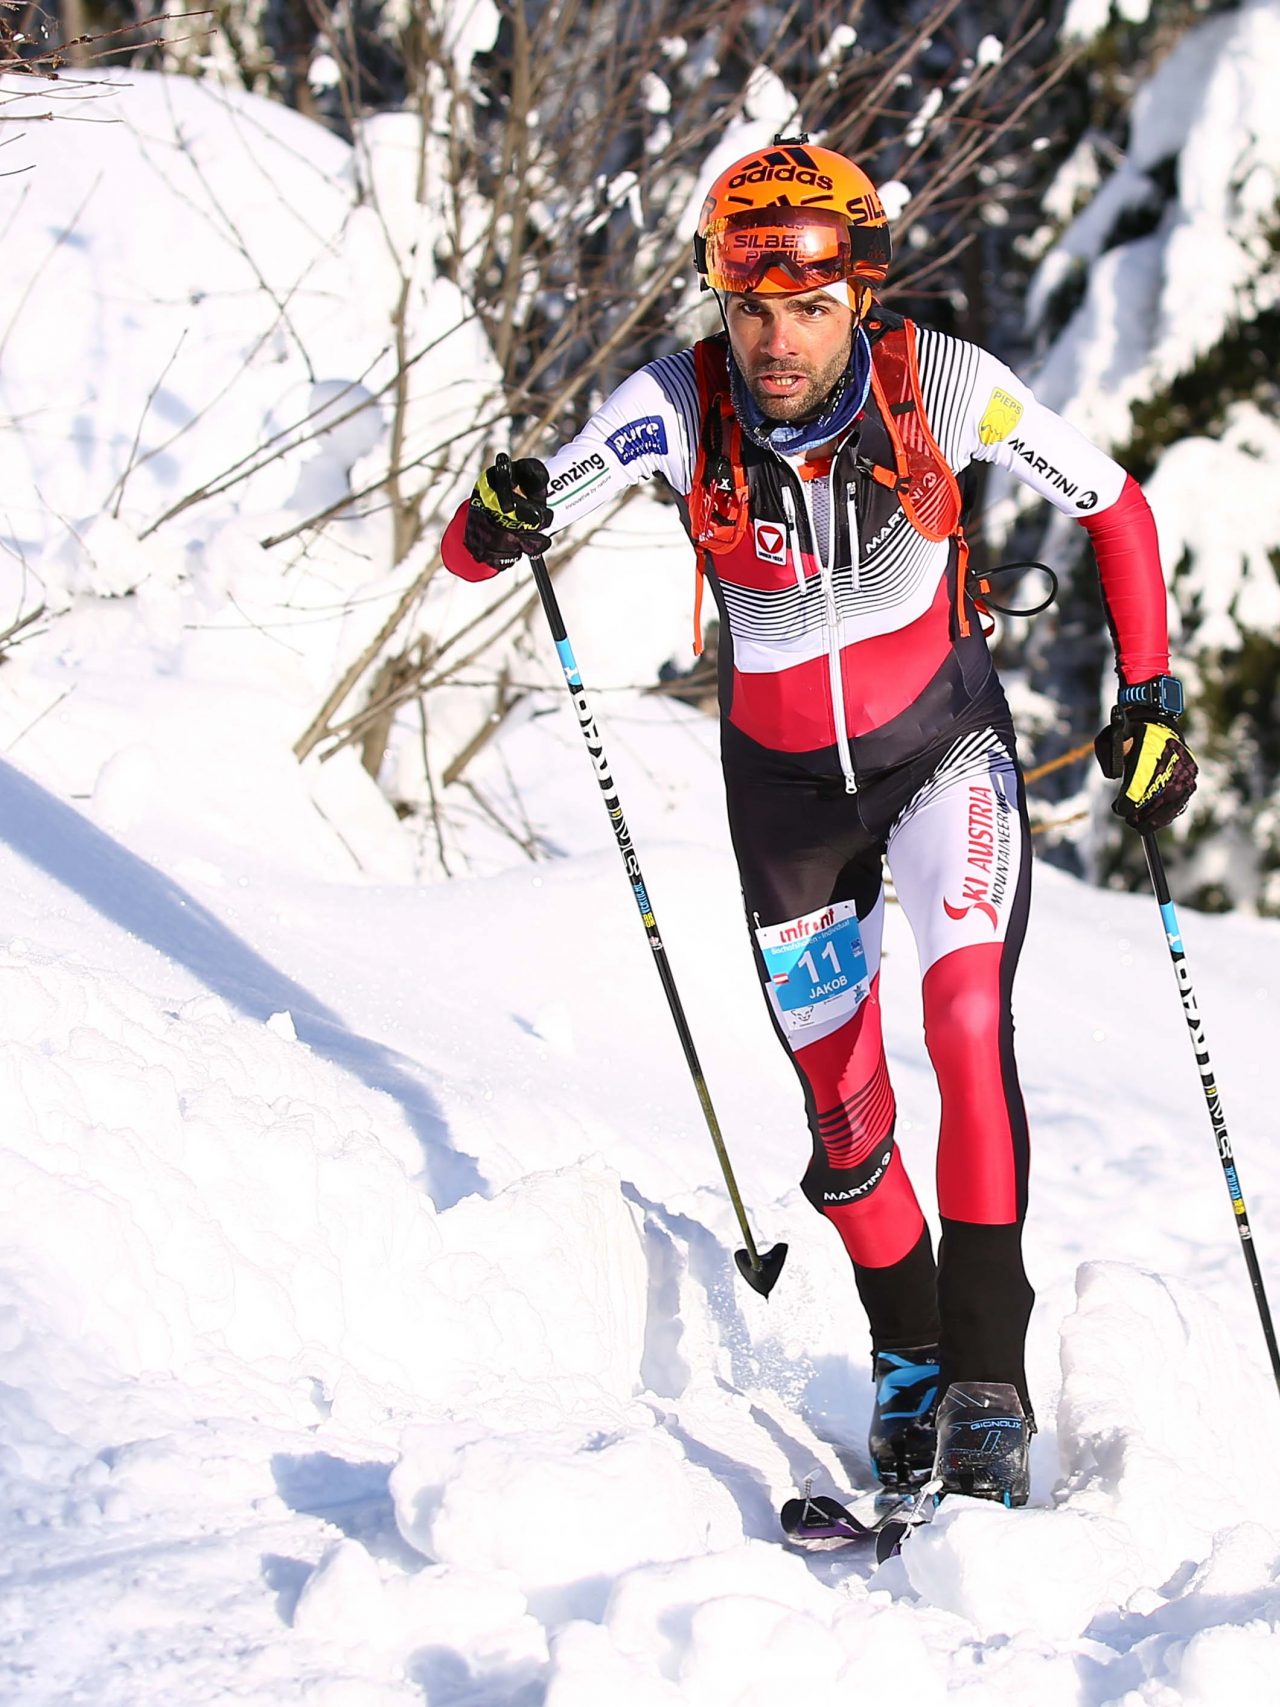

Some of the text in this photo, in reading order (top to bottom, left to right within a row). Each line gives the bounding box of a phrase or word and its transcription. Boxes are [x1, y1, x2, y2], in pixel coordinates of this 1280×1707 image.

[728, 165, 833, 191] adidas
[993, 391, 1022, 415] PIEPS
[613, 422, 659, 455] pure
[1008, 438, 1078, 498] MARTINI
[866, 487, 924, 554] MARNI
[967, 786, 994, 874] AUSTRIA
[991, 789, 1011, 909] MOUNTAINEERING
[779, 907, 835, 944] infront
[798, 940, 842, 984] 11
[809, 975, 848, 999] JAKOB
[823, 1167, 884, 1201] MARTINI
[970, 1420, 1022, 1431] GIGNOUX
